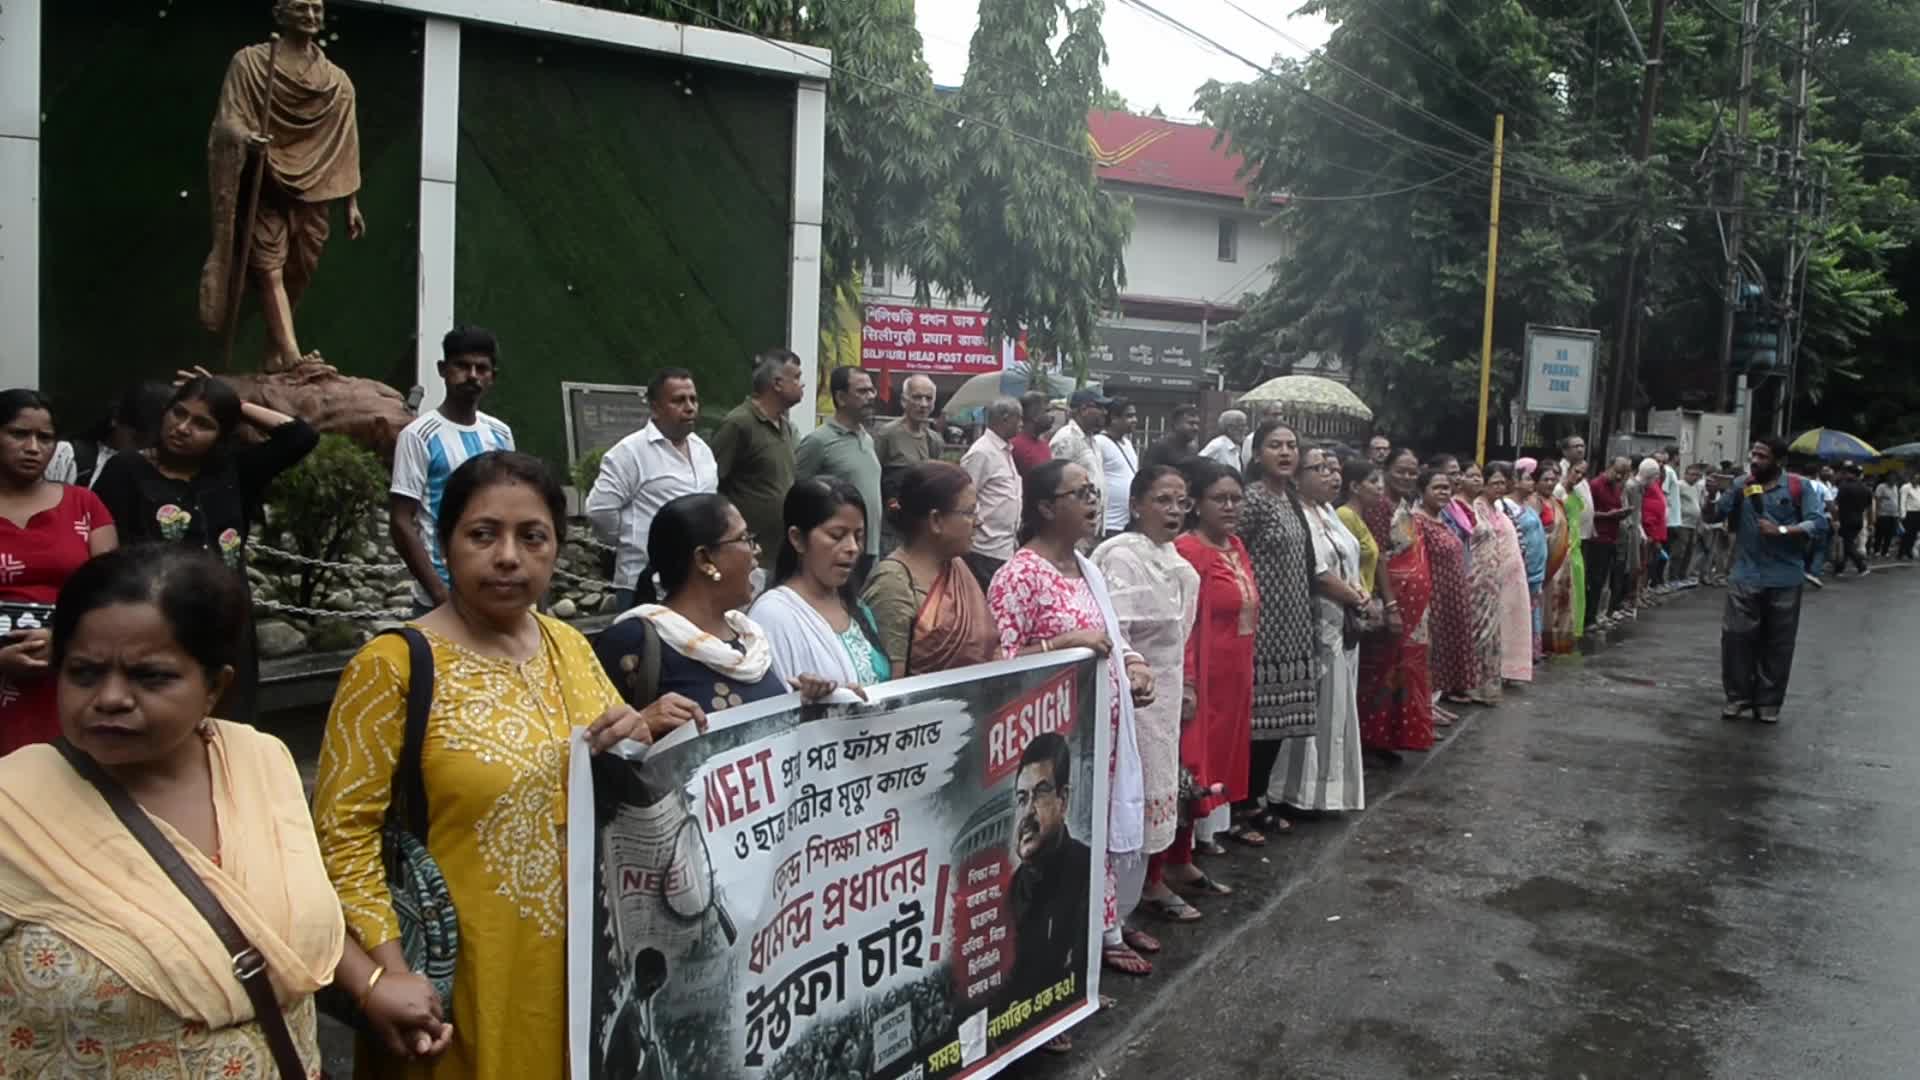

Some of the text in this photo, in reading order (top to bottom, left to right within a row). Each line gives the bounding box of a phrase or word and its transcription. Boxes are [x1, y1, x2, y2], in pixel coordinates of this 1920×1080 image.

[908, 350, 935, 362] HEAD
[937, 352, 962, 363] POST
[964, 354, 997, 366] OFFICE
[922, 332, 952, 347] प्रधान
[989, 679, 1071, 768] RESIGN
[703, 749, 776, 832] NEET
[807, 741, 839, 771] পত্র
[843, 732, 892, 760] ফাঁস
[896, 720, 943, 751] কান্ডে
[734, 831, 748, 860] ও
[836, 775, 872, 816] মৃত্যু
[877, 763, 928, 793] কান্ডে
[806, 835, 861, 874] শিক্ষা
[866, 808, 900, 853] মন্ত্রী
[822, 849, 928, 930] প্রধানের
[744, 942, 849, 1067] ইস্তফা
[987, 999, 1033, 1038] নাগরিক
[1033, 986, 1054, 1012] এক
